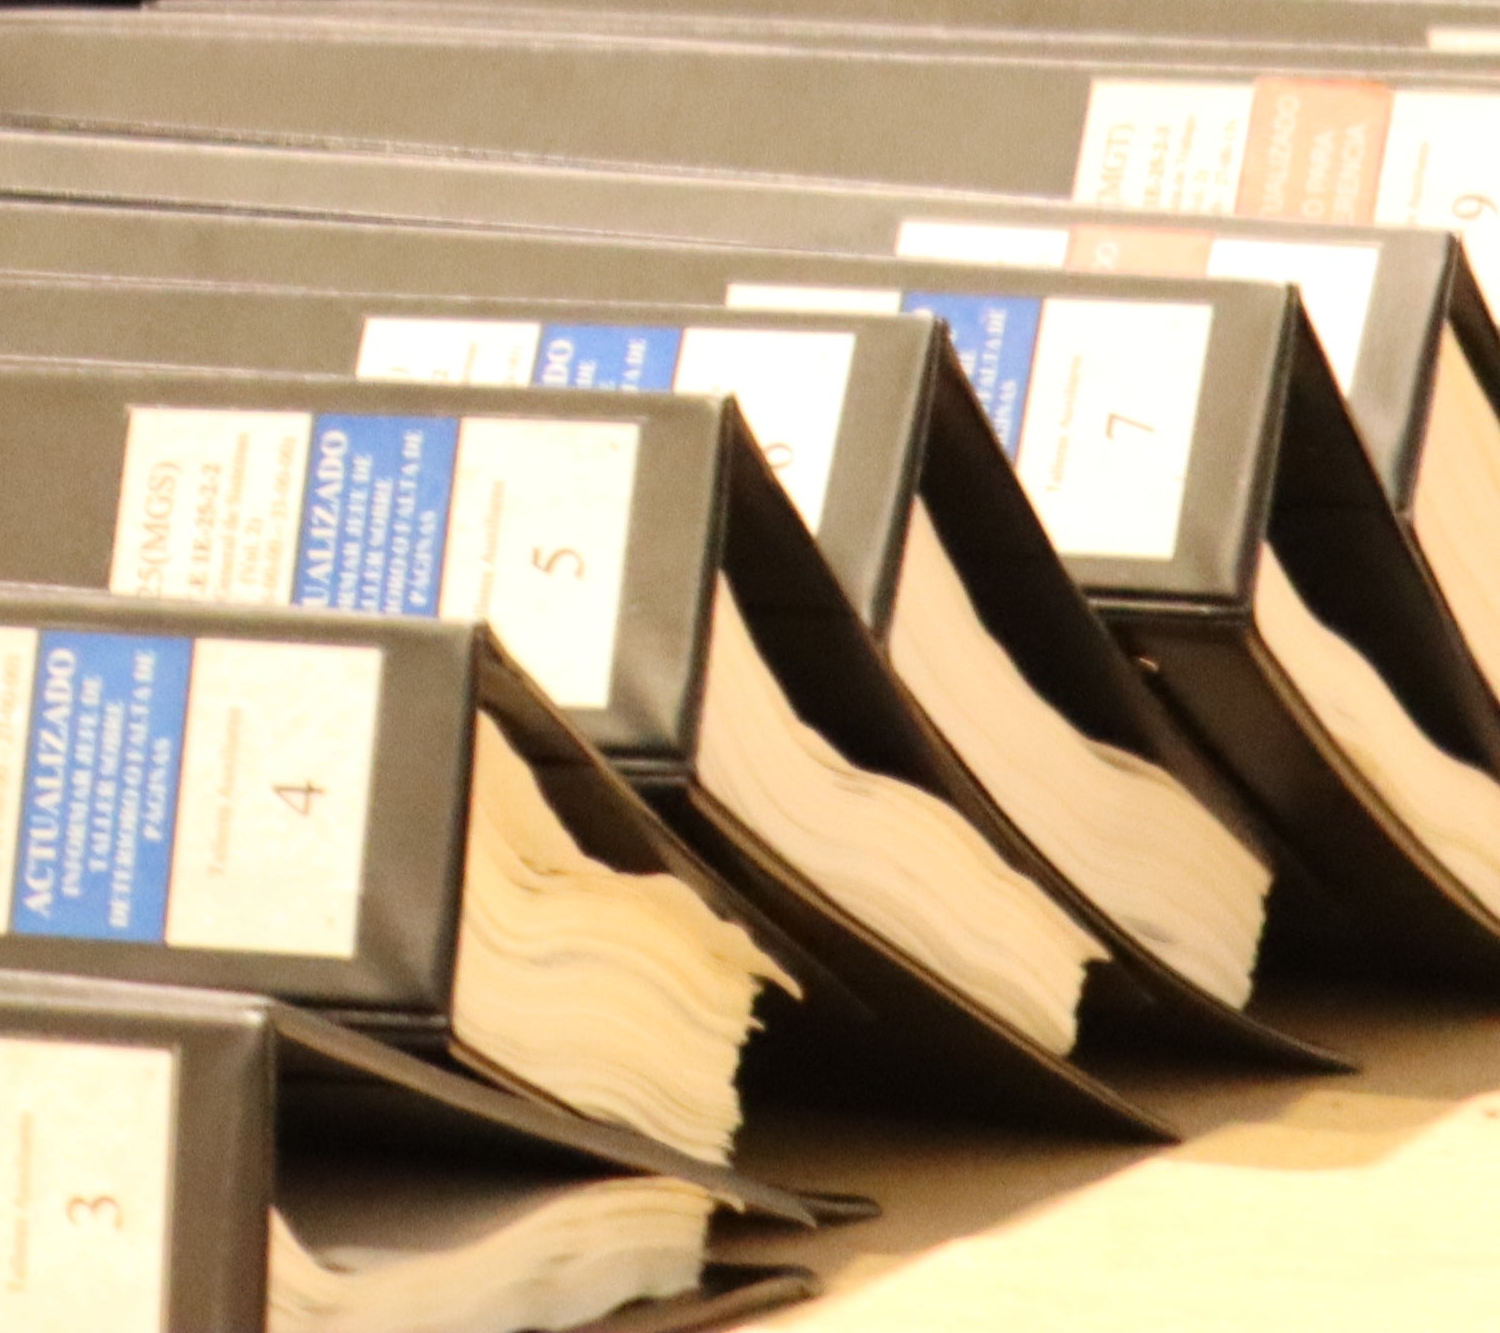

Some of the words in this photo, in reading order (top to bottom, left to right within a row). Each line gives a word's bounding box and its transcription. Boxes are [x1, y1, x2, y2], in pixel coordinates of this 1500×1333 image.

[1260, 95, 1300, 212] UALIZADO
[1452, 194, 1499, 220] 9
[1105, 413, 1157, 440] 7
[136, 461, 181, 598] 25(MGS)
[303, 431, 347, 604] UALIZADO
[338, 543, 359, 607] RMAR
[361, 552, 382, 606] LLER
[530, 547, 585, 579] 5
[22, 647, 75, 916] ACTUALIZADO
[268, 777, 326, 817] 4
[66, 1192, 123, 1230] 3
